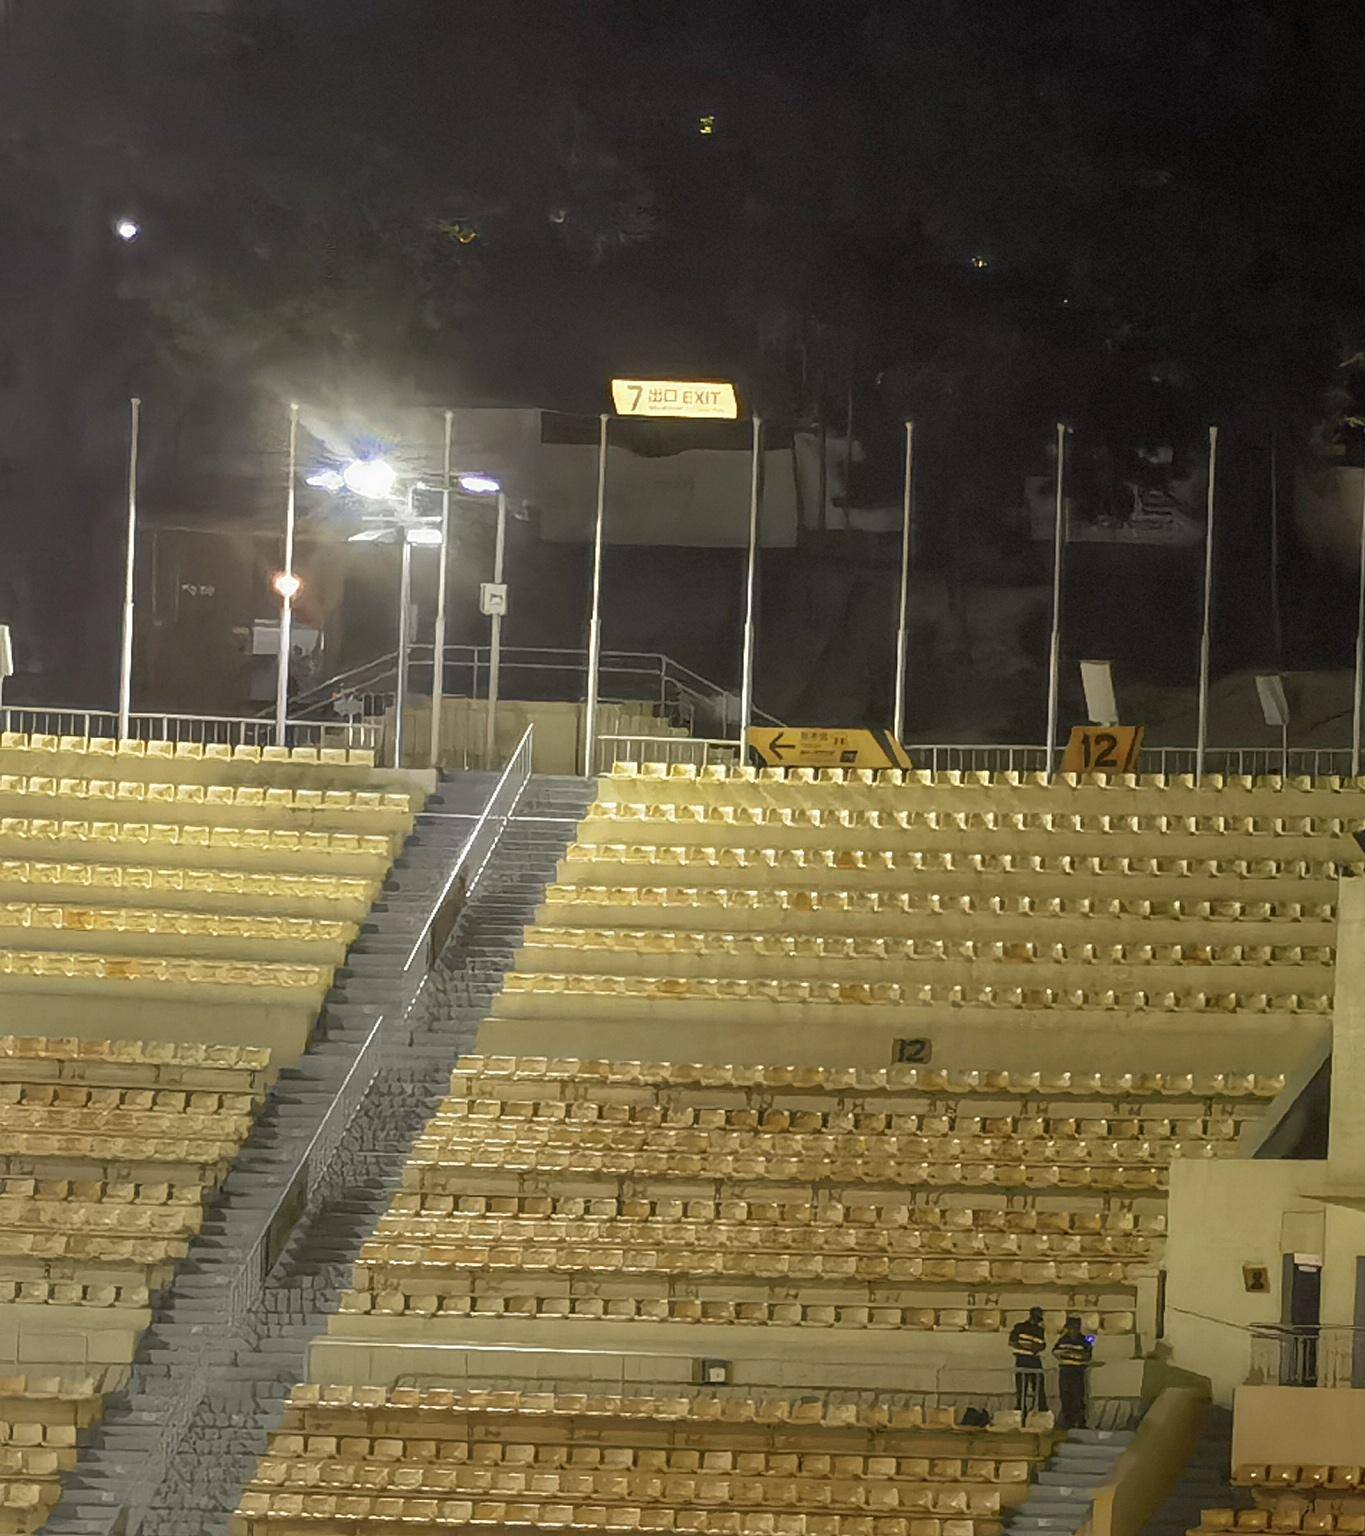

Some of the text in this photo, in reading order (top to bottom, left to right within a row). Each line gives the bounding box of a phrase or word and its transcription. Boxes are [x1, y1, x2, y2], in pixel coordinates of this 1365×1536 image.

[627, 385, 643, 411] 7
[648, 388, 677, 402] 出口
[683, 391, 721, 405] EXIT
[1081, 733, 1118, 770] 12
